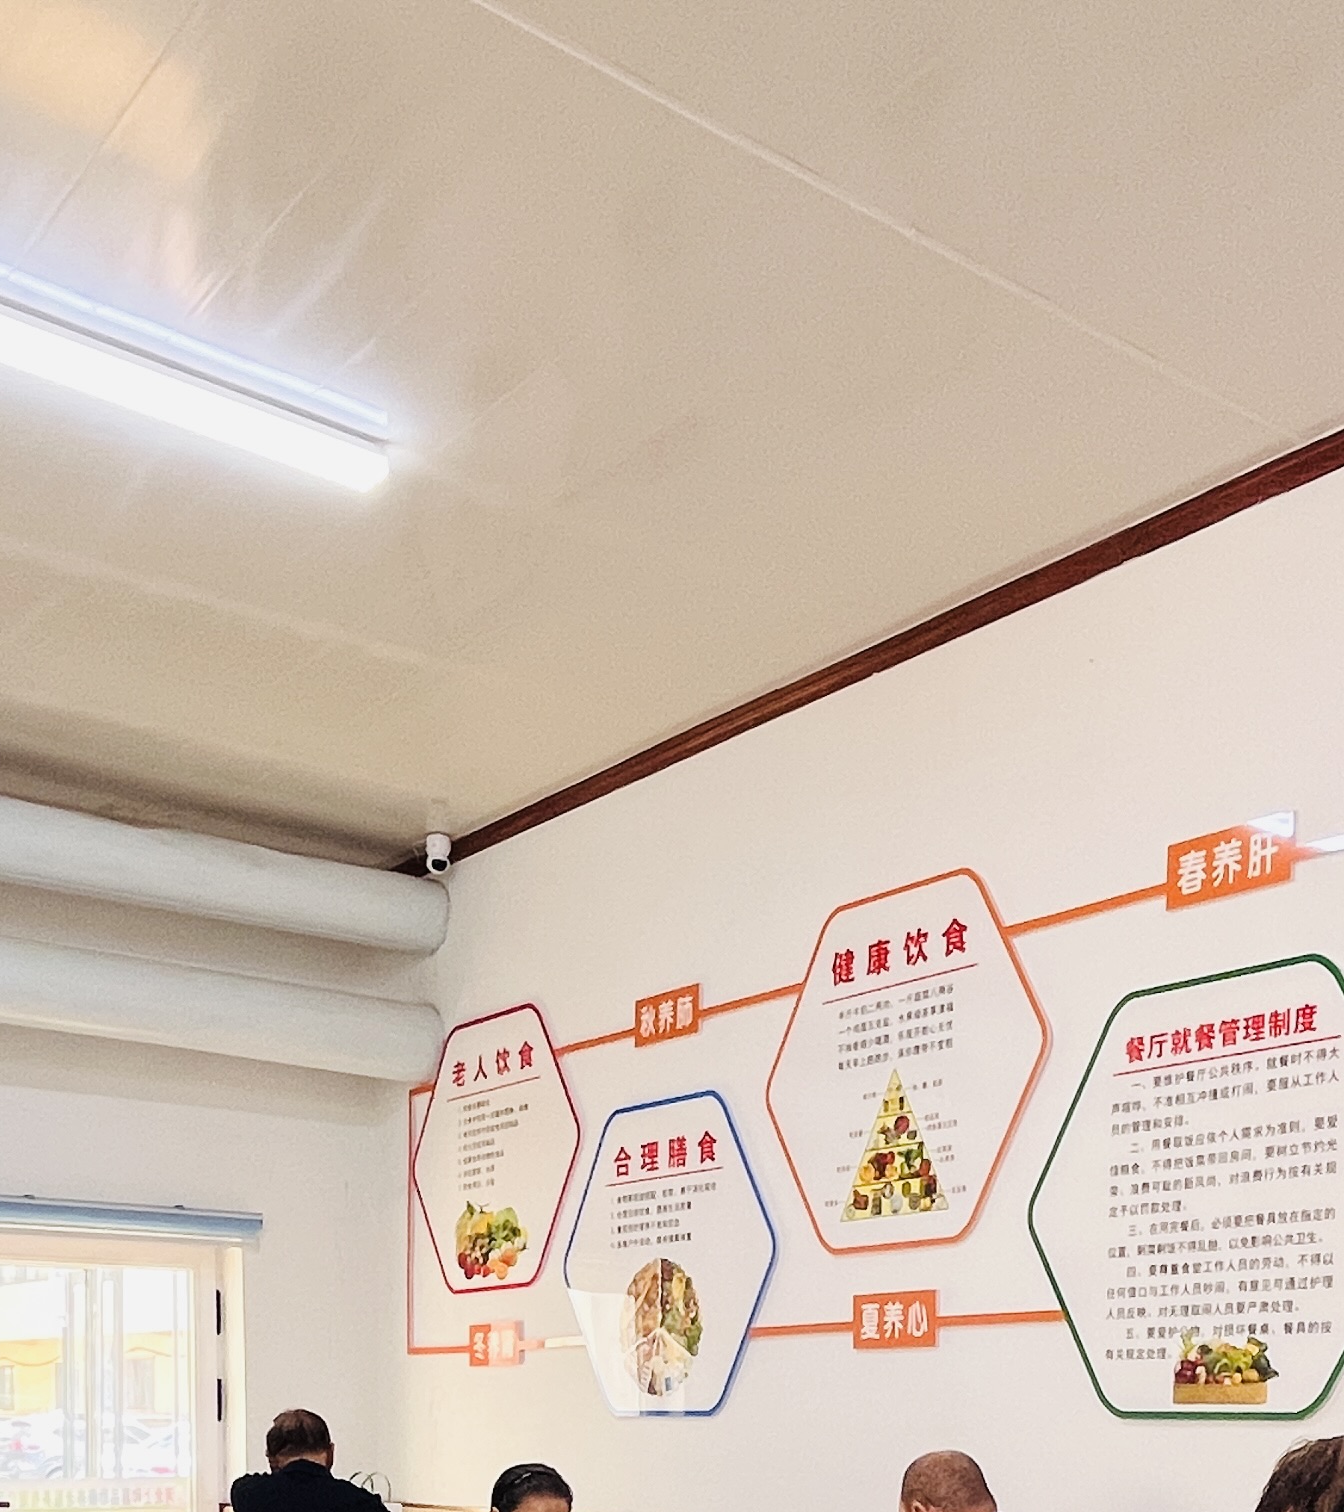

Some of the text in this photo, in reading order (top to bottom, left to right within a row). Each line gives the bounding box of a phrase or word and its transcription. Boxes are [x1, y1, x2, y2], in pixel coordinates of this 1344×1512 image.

[1177, 833, 1279, 895] 春养肝
[832, 918, 967, 986] 健康饮食
[1126, 1004, 1317, 1063] 餐厅就餐管理制度
[452, 1041, 534, 1086] 老人饮食
[614, 1130, 717, 1177] 合理膳食
[860, 1300, 928, 1340] 夏养心
